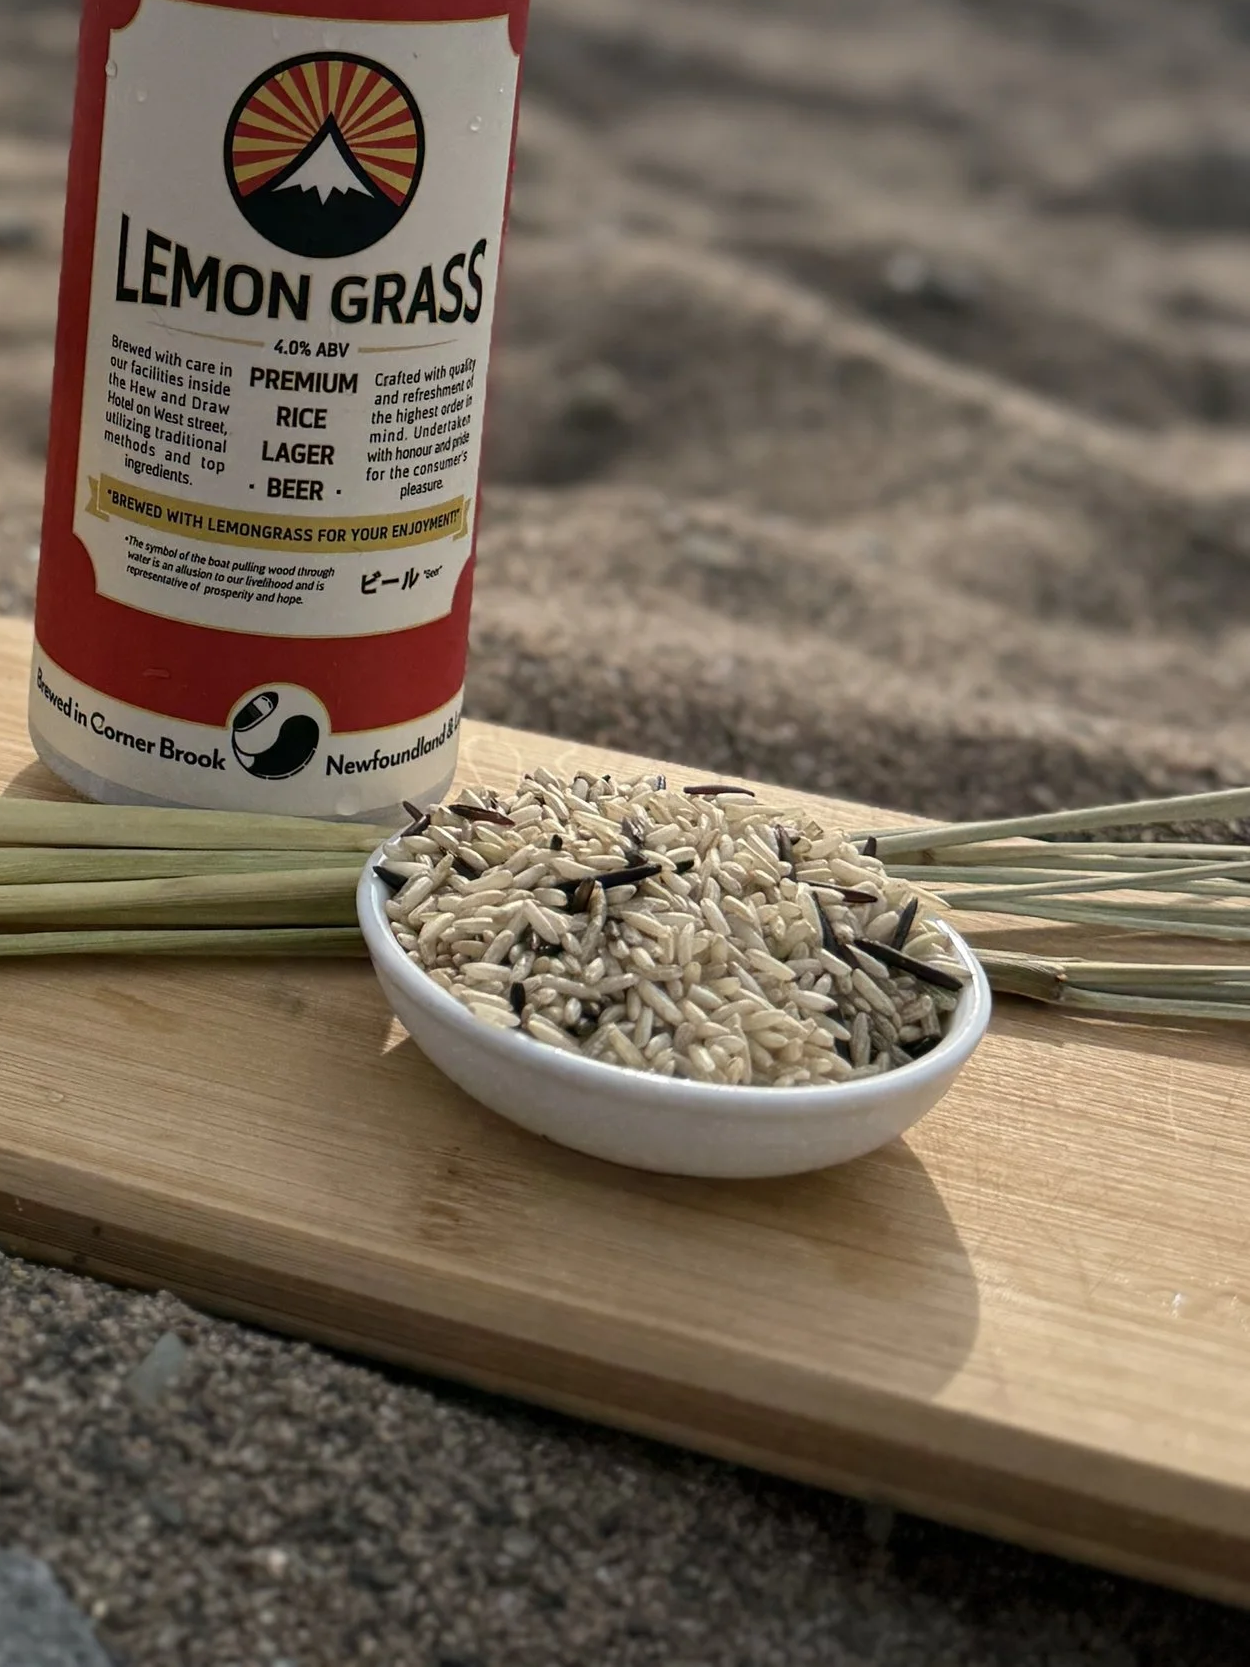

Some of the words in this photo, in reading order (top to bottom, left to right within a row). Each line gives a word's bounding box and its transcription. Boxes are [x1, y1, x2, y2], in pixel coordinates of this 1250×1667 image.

[116, 211, 311, 321] LEMON
[331, 238, 487, 324] GRASS
[112, 334, 152, 360] Brewed
[155, 350, 182, 368] with
[186, 358, 216, 375] care
[219, 362, 233, 378] in
[274, 339, 311, 357] 4.0%
[316, 342, 350, 358] ABV
[110, 356, 128, 370] our
[131, 360, 184, 387] facilities
[188, 376, 231, 396] inside
[250, 366, 359, 394] PREMIUM
[375, 369, 421, 387] Crafted
[424, 365, 447, 382] with
[449, 357, 477, 379] quality
[108, 372, 126, 390] the
[130, 380, 157, 399] Hew
[161, 391, 187, 407] and
[192, 396, 230, 415] Draw
[374, 390, 399, 406] and
[402, 380, 465, 404] refreshment
[466, 374, 475, 389] of
[107, 390, 134, 412] Hotel
[136, 403, 151, 417] on
[154, 406, 184, 426] West
[187, 415, 228, 436] street,
[276, 405, 328, 430] RICE
[371, 410, 392, 425] the
[396, 405, 438, 425] highest
[441, 398, 464, 416] order
[465, 394, 473, 408] in
[105, 410, 151, 439] utilizing
[155, 426, 227, 454] traditional
[369, 427, 408, 444] mind.
[414, 413, 471, 439] Undertaken
[104, 429, 156, 457] methods
[164, 449, 191, 466] and
[201, 457, 225, 475] top
[261, 440, 336, 465] LAGER
[367, 447, 393, 463] with
[395, 444, 432, 461] honour
[435, 437, 451, 453] and
[452, 430, 470, 451] pride
[124, 454, 193, 486] ingredients.
[366, 467, 385, 482] for
[389, 465, 409, 480] the
[267, 477, 324, 501] BEER
[166, 507, 203, 529] WITH
[207, 517, 313, 542] LEMONGRASS
[318, 528, 347, 542] FOR
[351, 526, 388, 542] YOUR
[127, 550, 151, 566] water
[152, 556, 161, 568] is
[161, 560, 174, 572] an
[175, 563, 213, 580] allusion
[214, 572, 225, 583] to
[226, 575, 245, 586] our
[245, 575, 294, 590] livelihood
[294, 580, 315, 591] and
[315, 580, 325, 592] is
[146, 542, 178, 559] symbol
[179, 550, 191, 562] of
[190, 552, 207, 565] the
[208, 555, 231, 569] boat
[231, 561, 266, 575] pulling
[268, 565, 297, 576] wood
[297, 566, 336, 580] through
[126, 564, 188, 590] representative
[189, 581, 202, 592] of
[203, 584, 255, 603] prosperity
[255, 592, 276, 603] and
[276, 594, 304, 606] hope.
[361, 566, 420, 595] ビール
[36, 666, 73, 718] Brewed
[74, 702, 88, 728] in
[91, 711, 156, 755] Corner
[159, 736, 227, 771] Brook
[325, 724, 446, 777] Newfoundland
[446, 716, 454, 740] &
